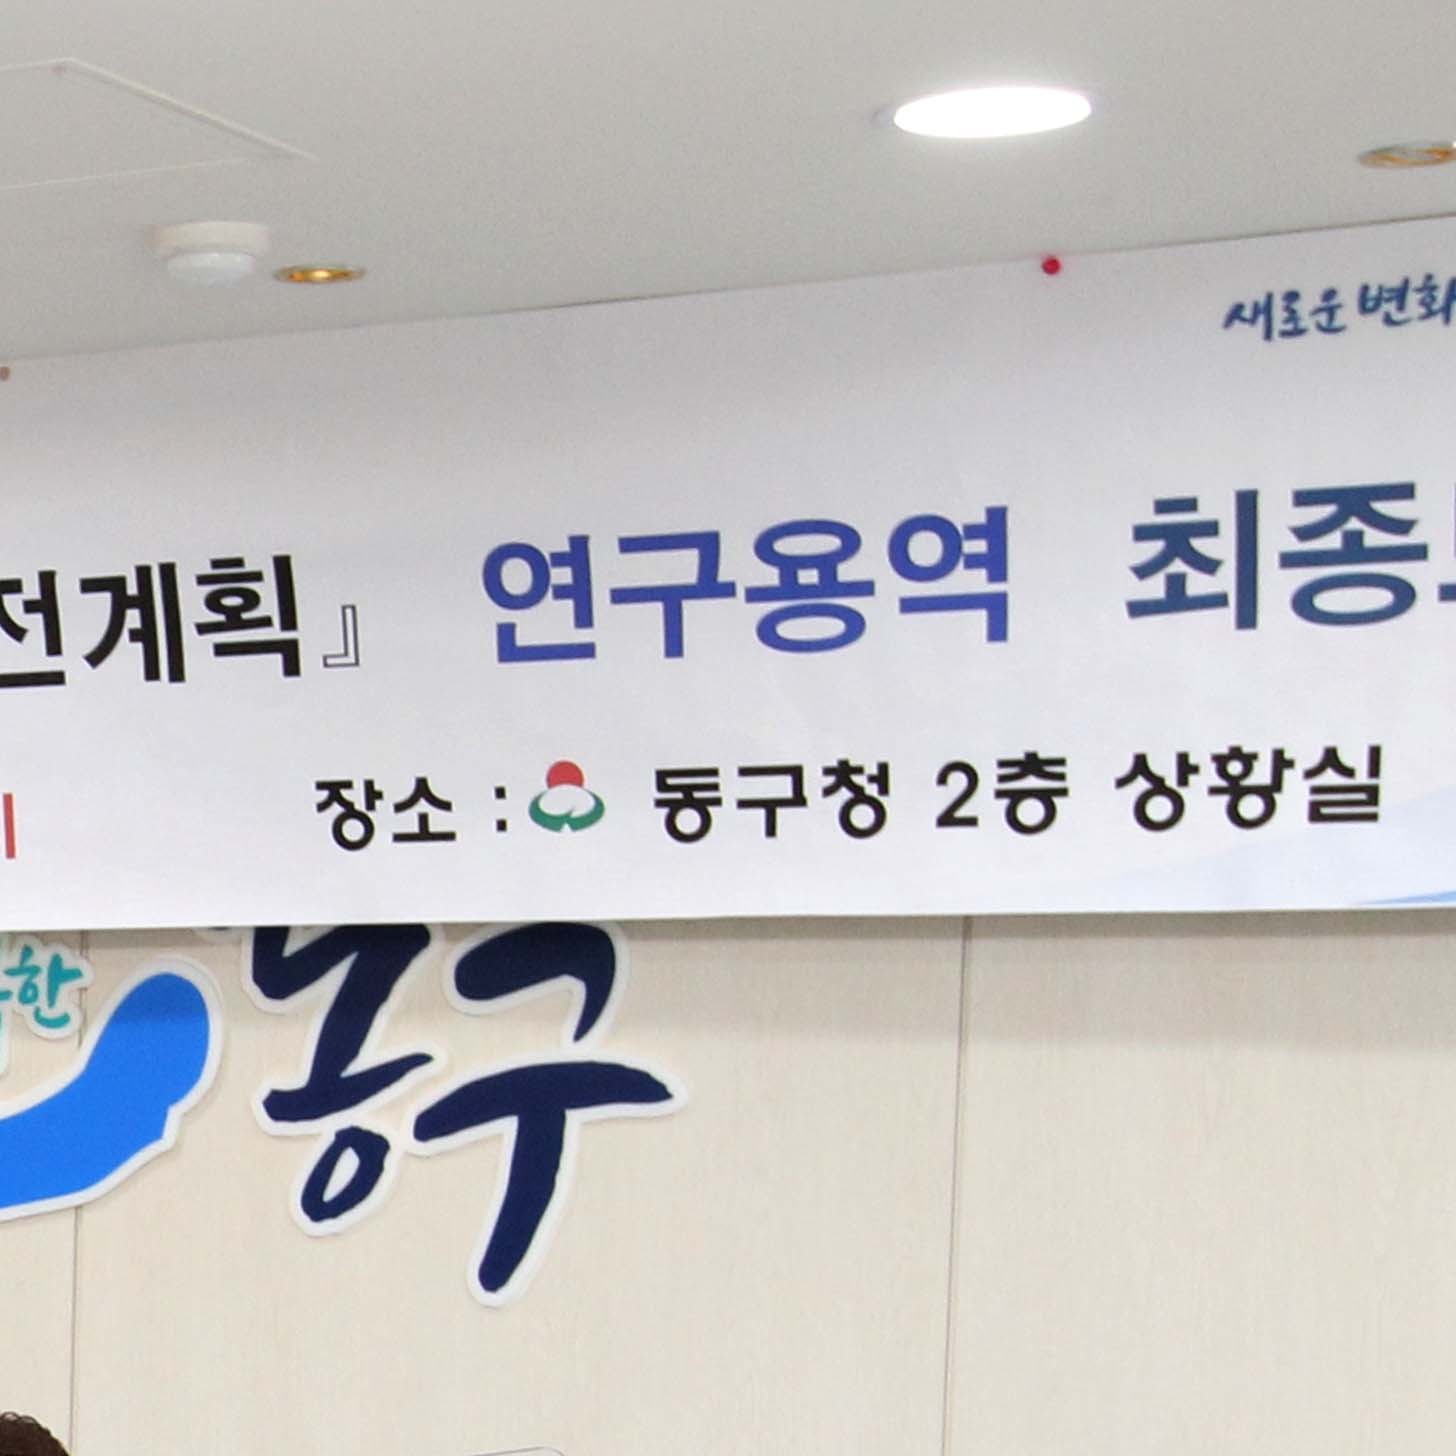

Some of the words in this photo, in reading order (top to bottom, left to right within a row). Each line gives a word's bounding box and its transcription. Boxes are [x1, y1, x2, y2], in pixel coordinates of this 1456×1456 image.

[1222, 287, 1347, 342] 새로운
[481, 505, 1009, 664] 연구용역
[1126, 481, 1456, 631] 최종
[653, 758, 891, 845] 동구청
[935, 750, 1070, 836] 2층
[1114, 744, 1383, 833] 상황실
